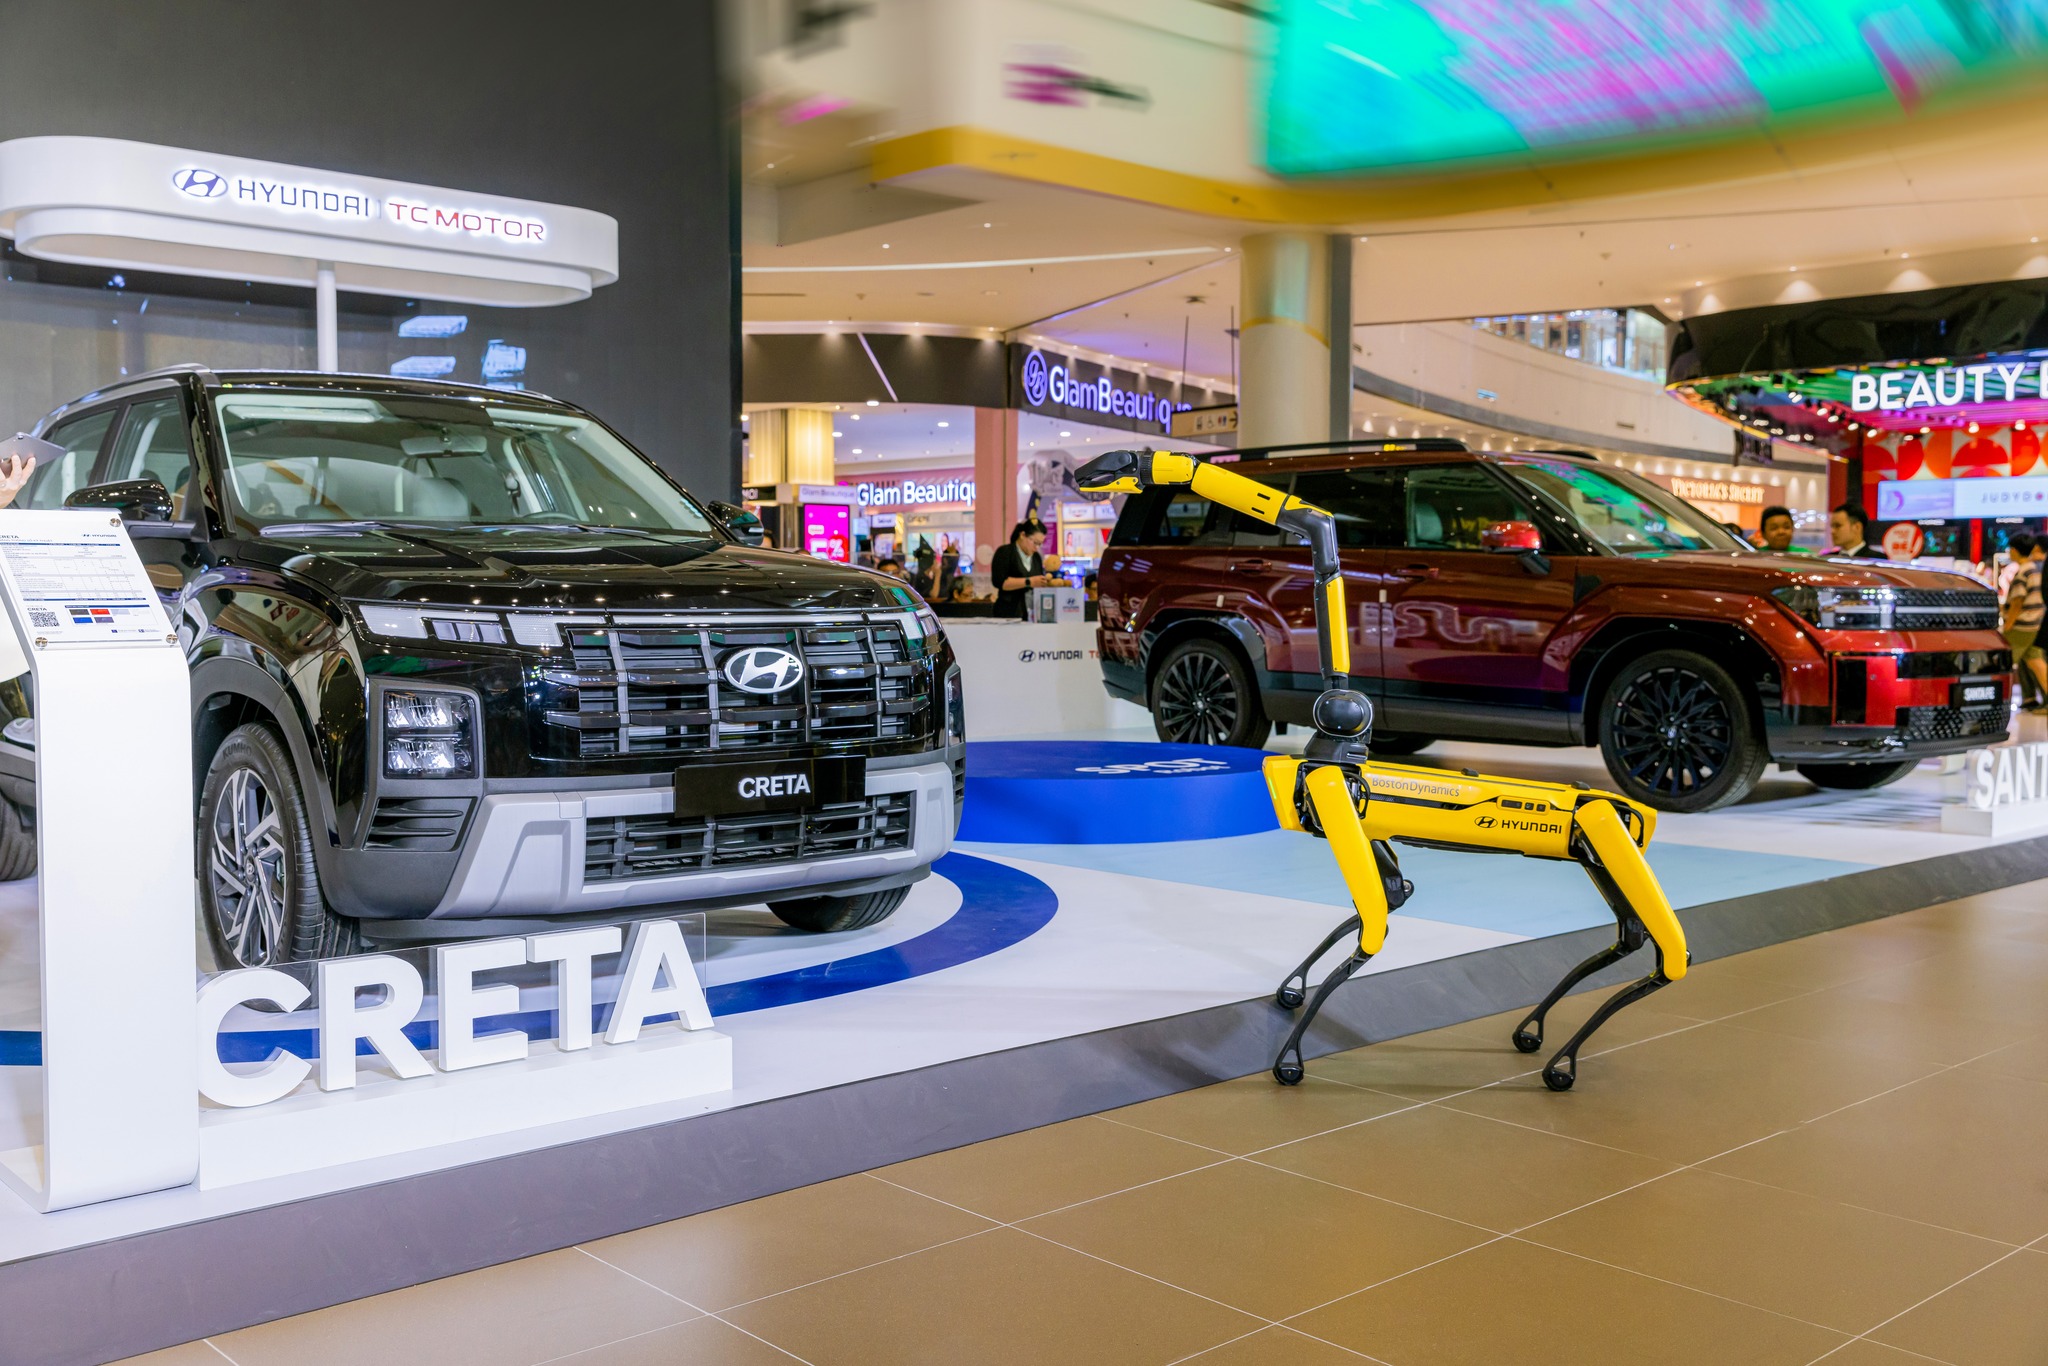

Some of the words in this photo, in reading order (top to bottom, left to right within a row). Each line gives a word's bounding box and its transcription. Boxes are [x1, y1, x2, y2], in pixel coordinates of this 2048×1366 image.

[238, 180, 369, 217] HYUNDAI
[389, 203, 428, 224] TC
[436, 210, 544, 241] MOTOR
[1852, 362, 2026, 412] BEAUTY
[857, 482, 900, 506] Glam
[1039, 650, 1083, 660] HYUNDAI
[222, 742, 252, 760] KUMHO
[738, 774, 811, 799] CRETA
[1501, 819, 1562, 835] HYUNDAI
[197, 919, 714, 1108] CRETA
